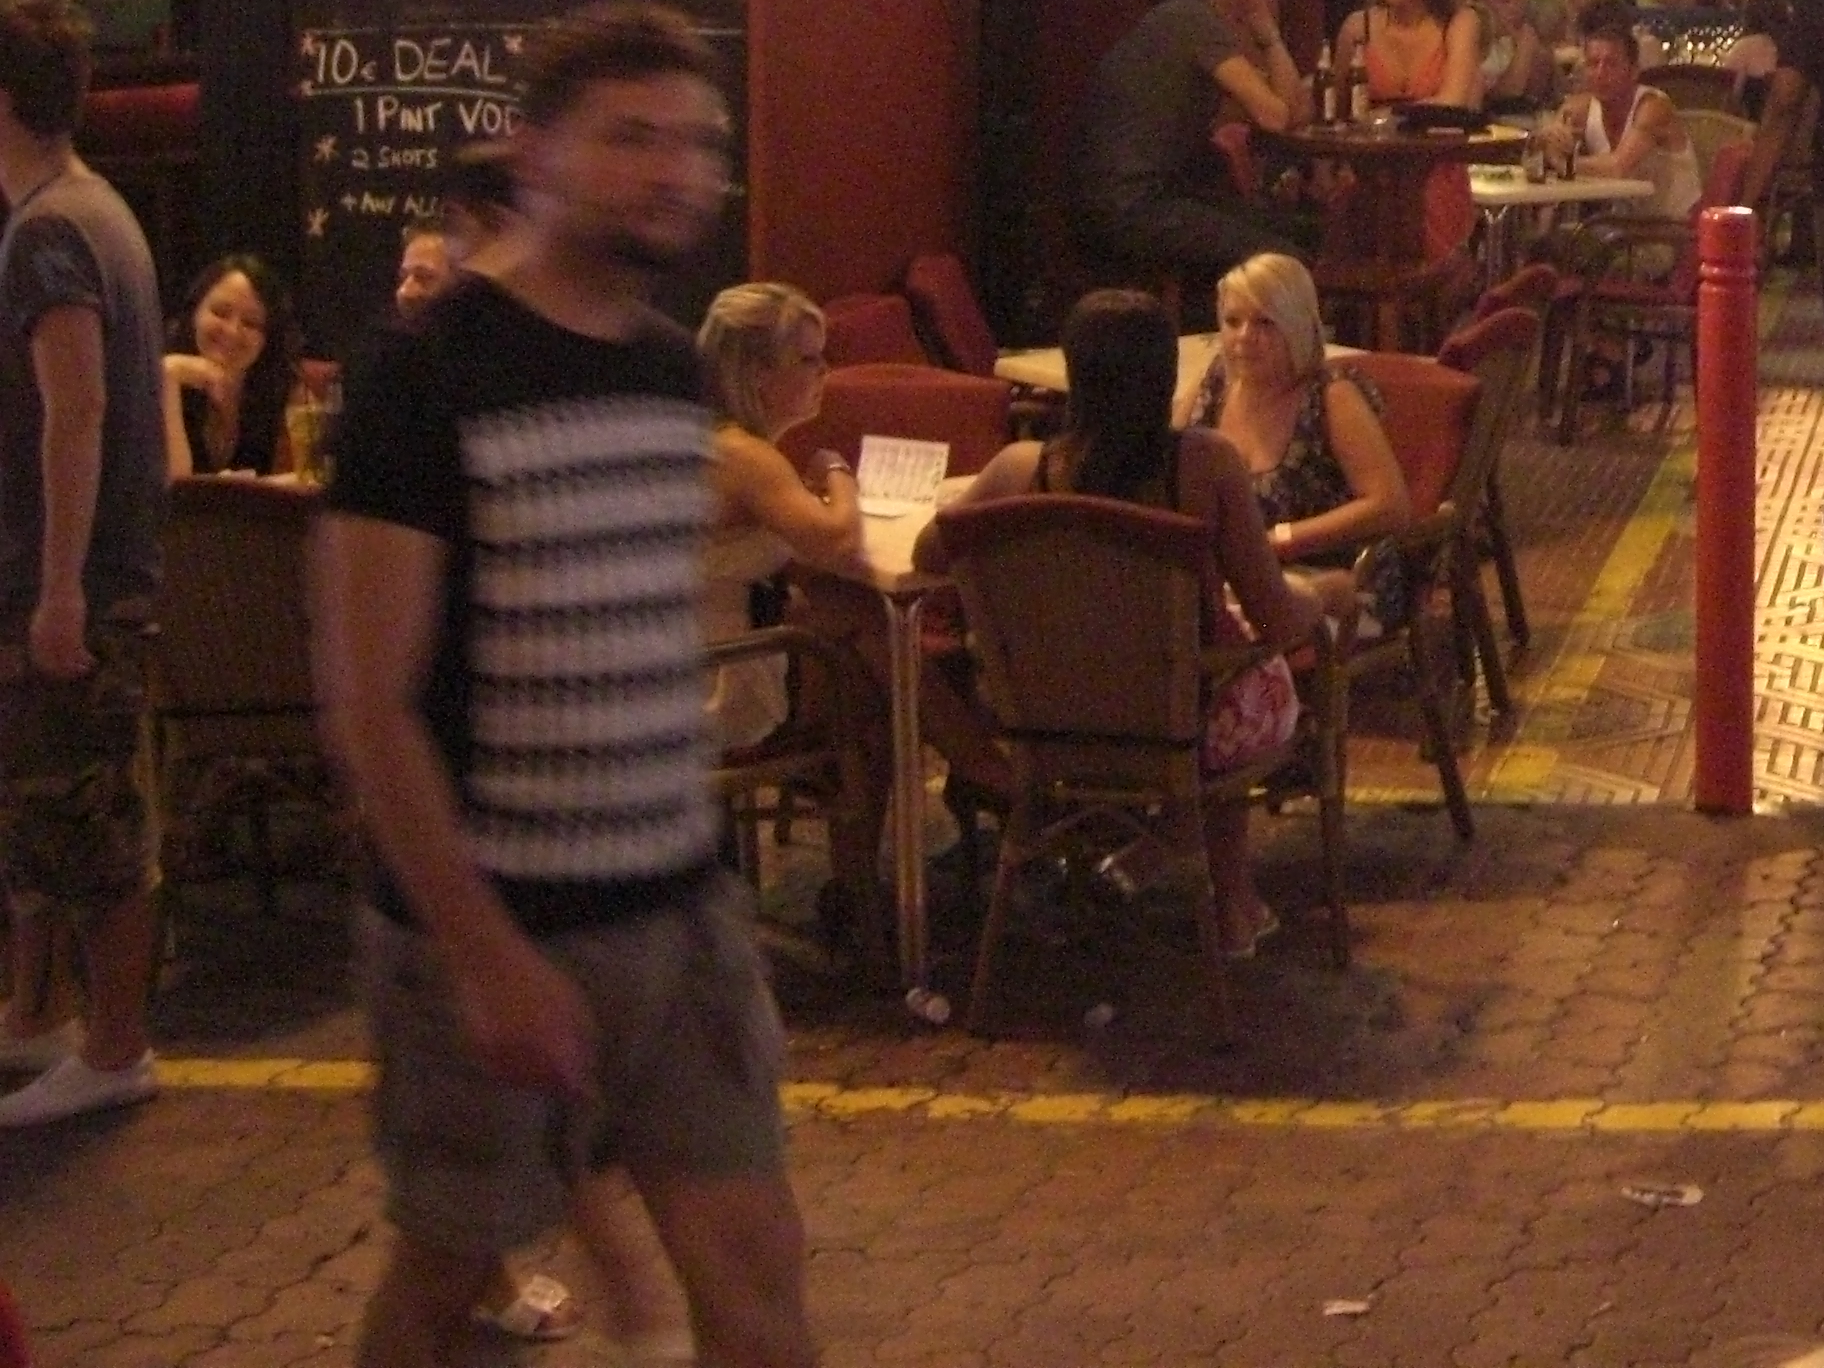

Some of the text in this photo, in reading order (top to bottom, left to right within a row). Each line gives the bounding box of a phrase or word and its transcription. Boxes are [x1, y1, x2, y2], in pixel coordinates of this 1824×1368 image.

[394, 38, 507, 83] DEAL
[355, 96, 365, 134] 1
[352, 148, 371, 171] 2
